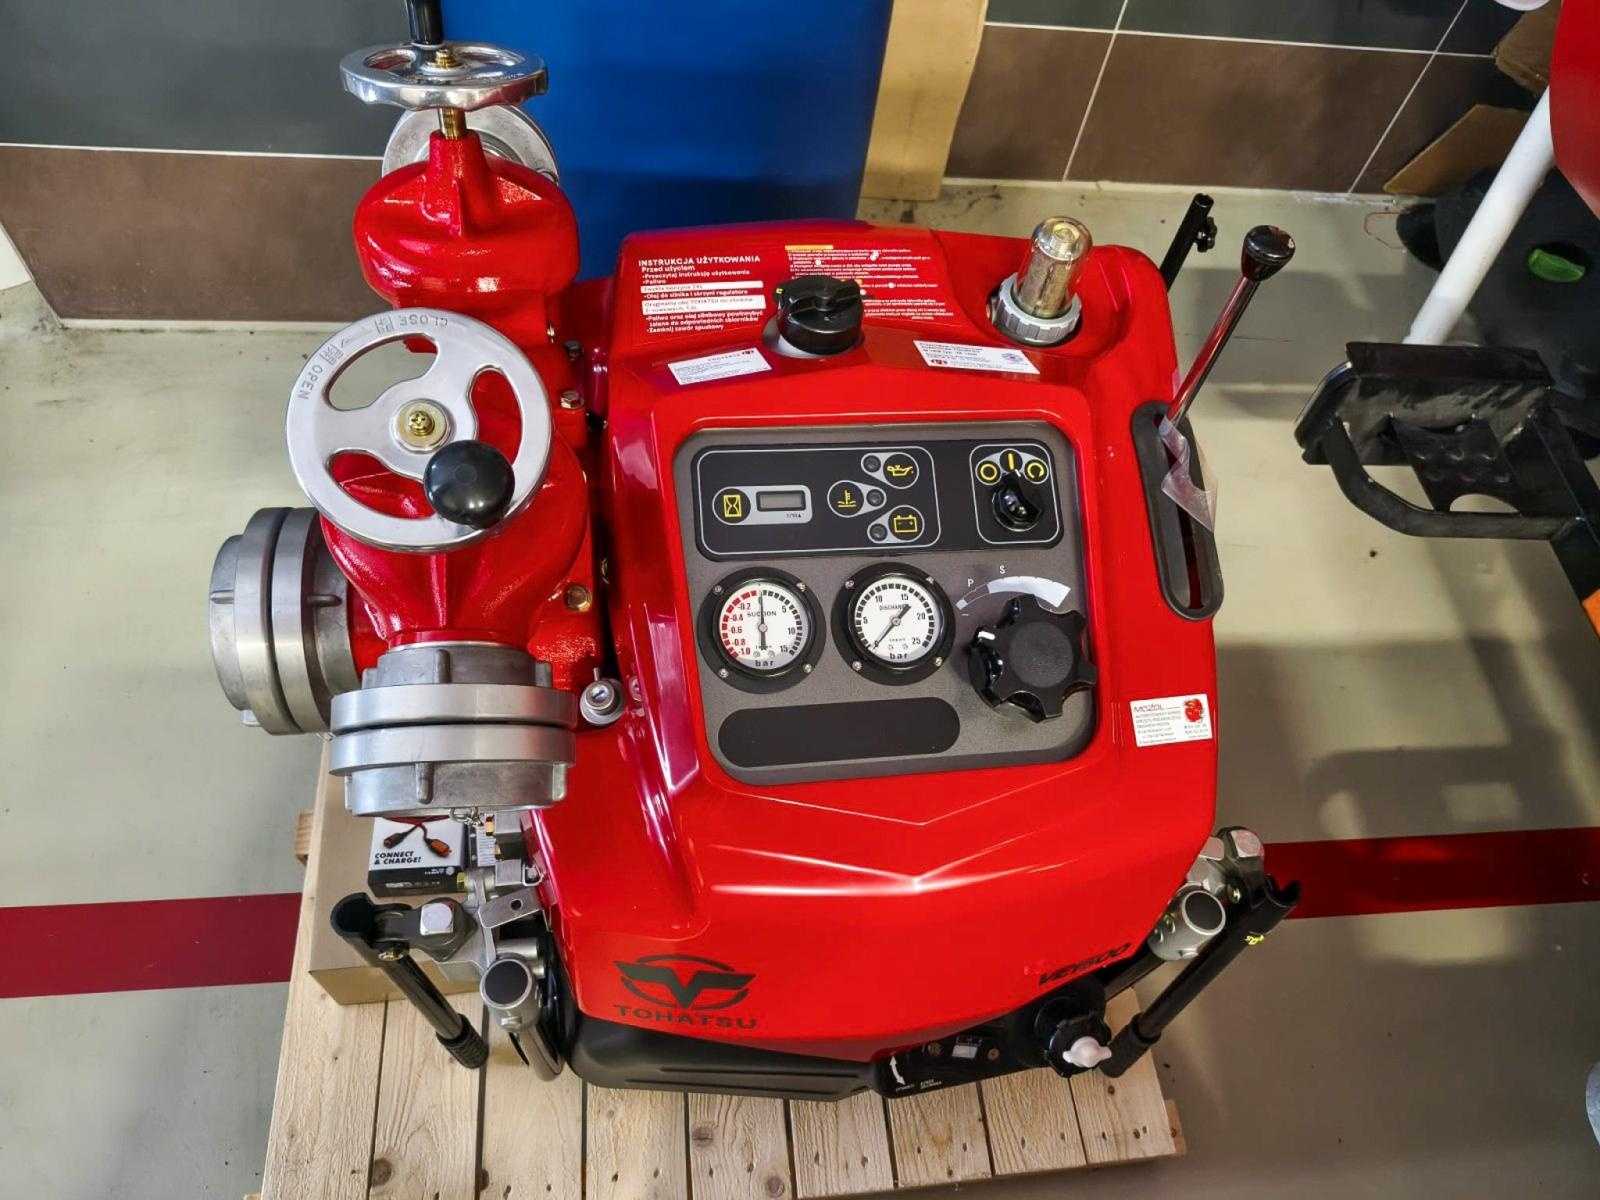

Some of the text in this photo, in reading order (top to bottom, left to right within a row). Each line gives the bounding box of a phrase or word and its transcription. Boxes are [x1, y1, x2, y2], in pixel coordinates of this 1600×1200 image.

[638, 256, 761, 267] INSTRUKCJA UŻYTKOWANIA
[297, 364, 323, 400] OPEN
[1000, 566, 1005, 574] S
[968, 579, 974, 587] P
[375, 851, 414, 859] CONNECT
[612, 1004, 757, 1030] TOHATSU
